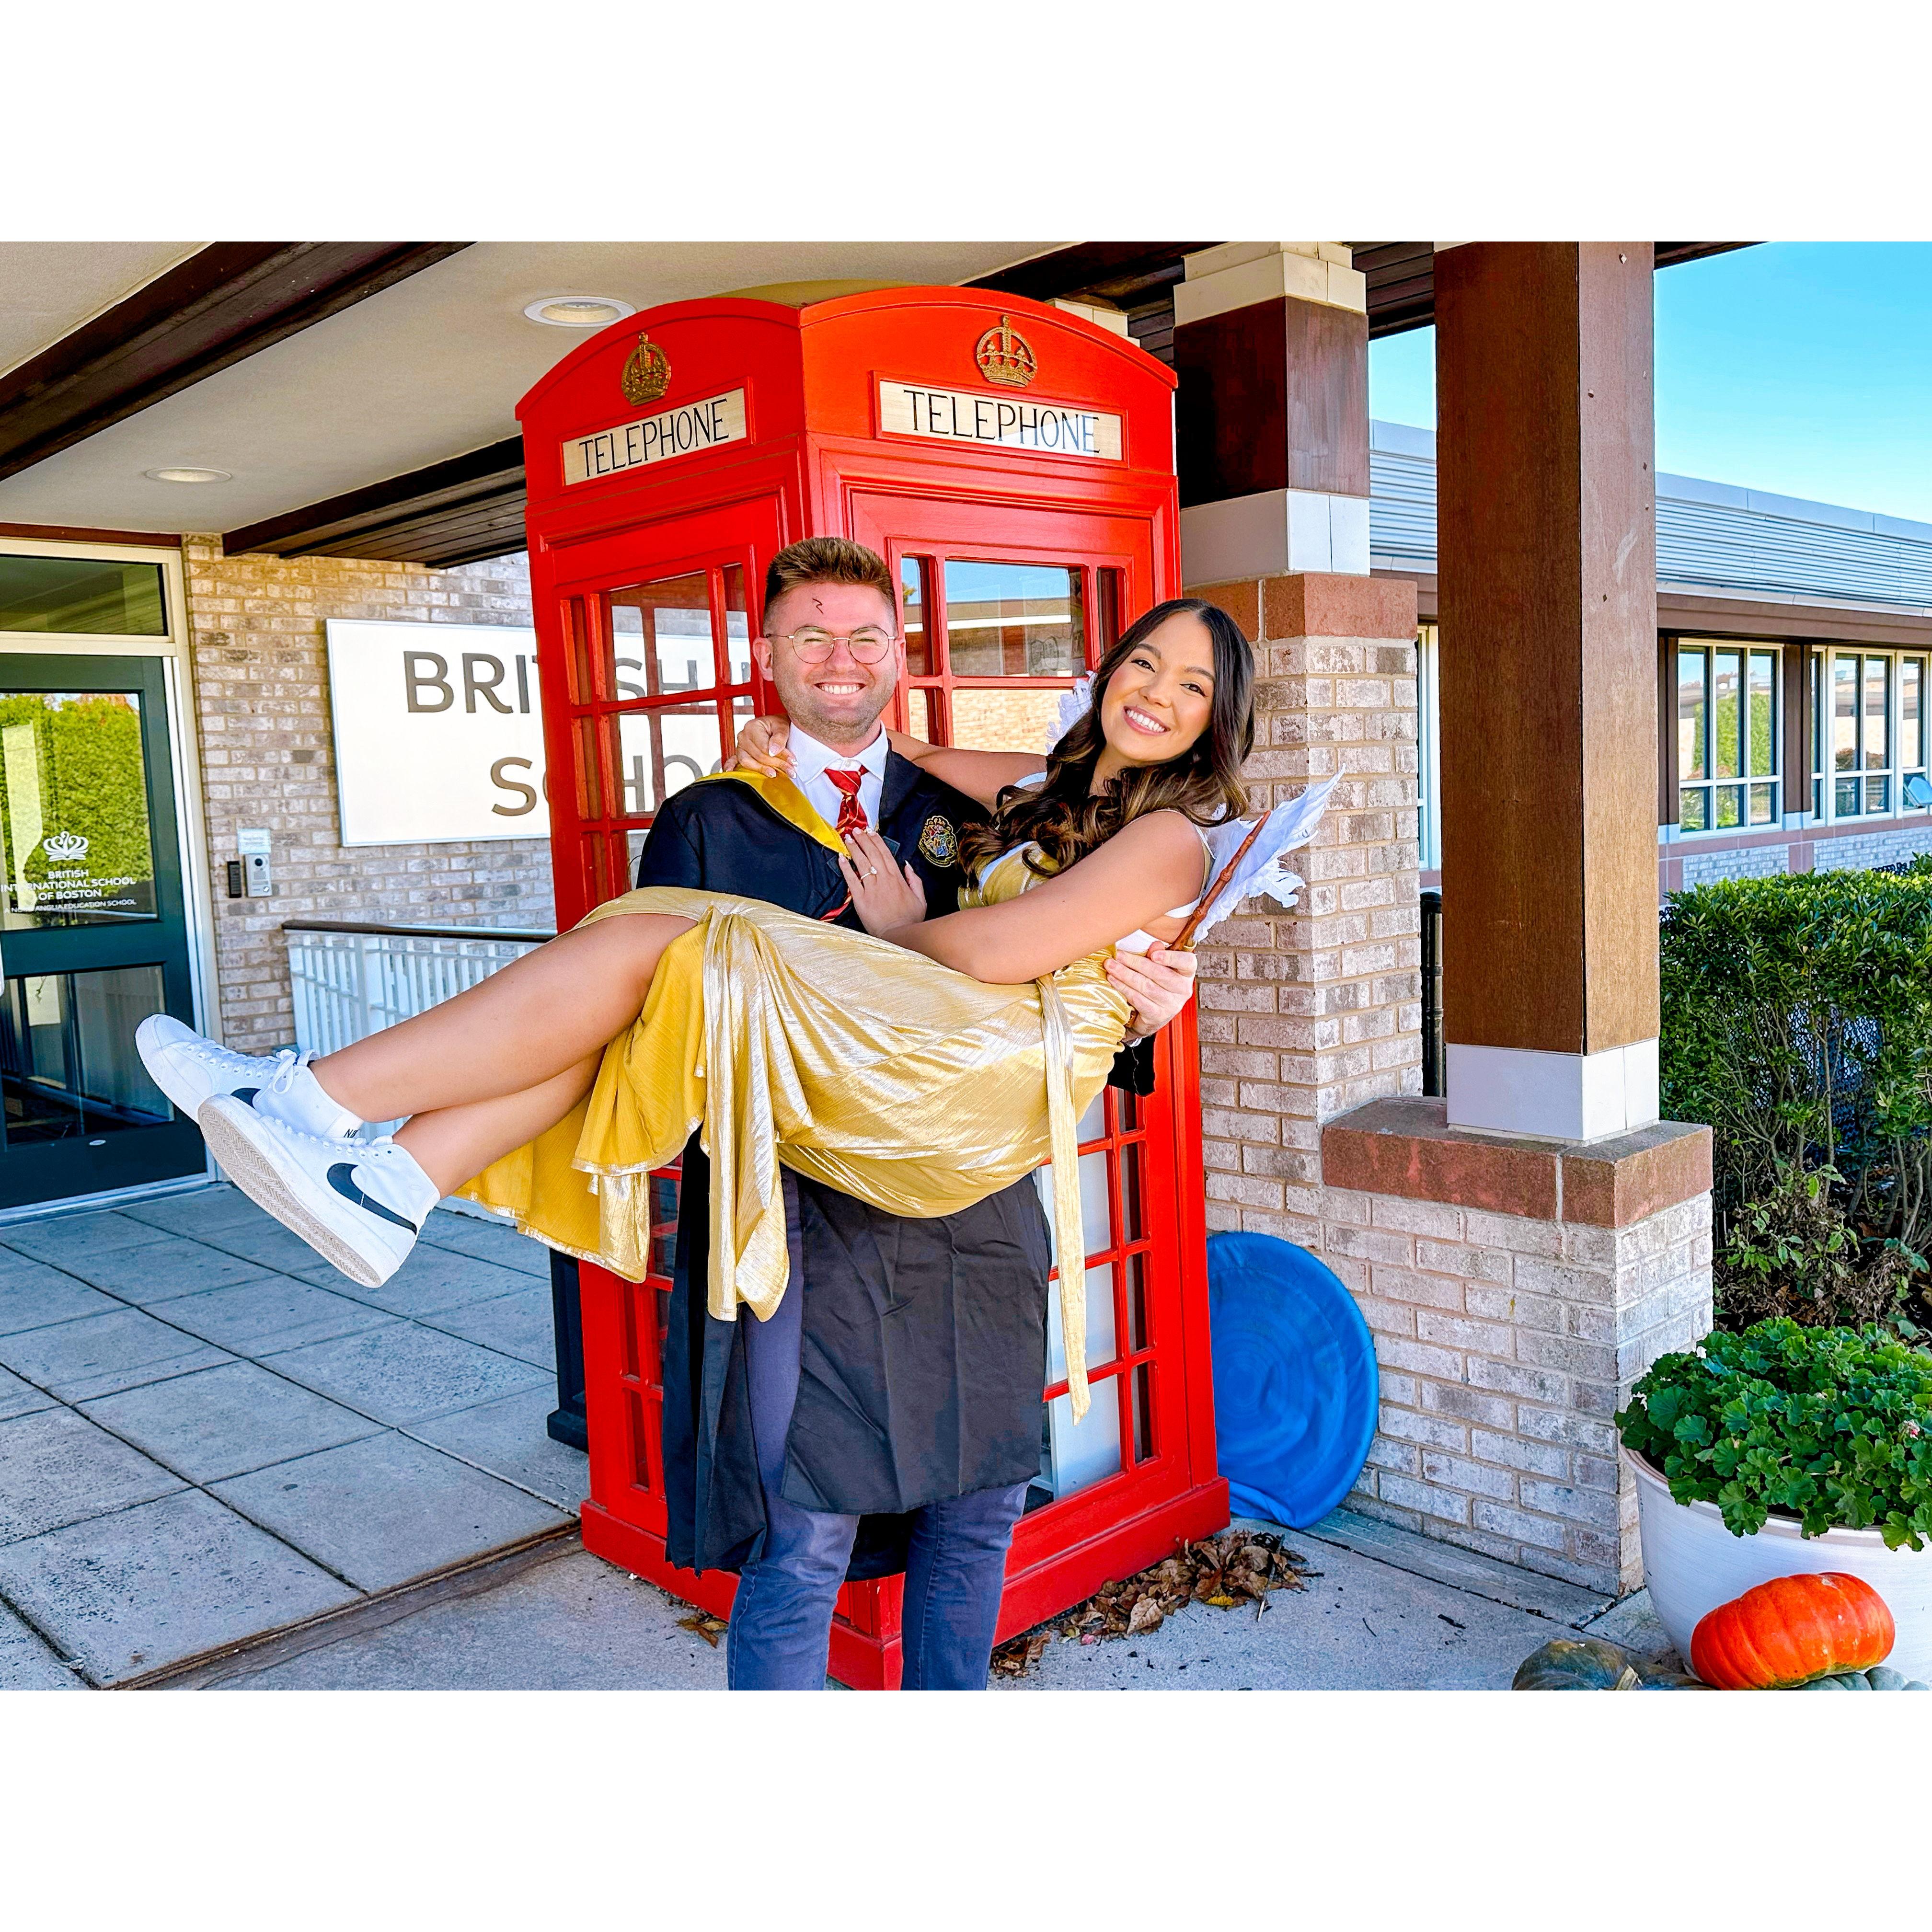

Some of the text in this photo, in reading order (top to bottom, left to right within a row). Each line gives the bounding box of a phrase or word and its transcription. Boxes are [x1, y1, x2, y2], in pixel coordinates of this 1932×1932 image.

[904, 389, 1101, 454] TELEPHONE
[578, 398, 730, 478] TELEPHONE
[403, 651, 699, 714] BRISH
[48, 869, 89, 879] BRITISH
[91, 876, 137, 887] SCHOOL
[38, 889, 102, 901] OF BOSTON
[64, 901, 106, 909] EDUCATION
[107, 899, 137, 907] SCHOOL
